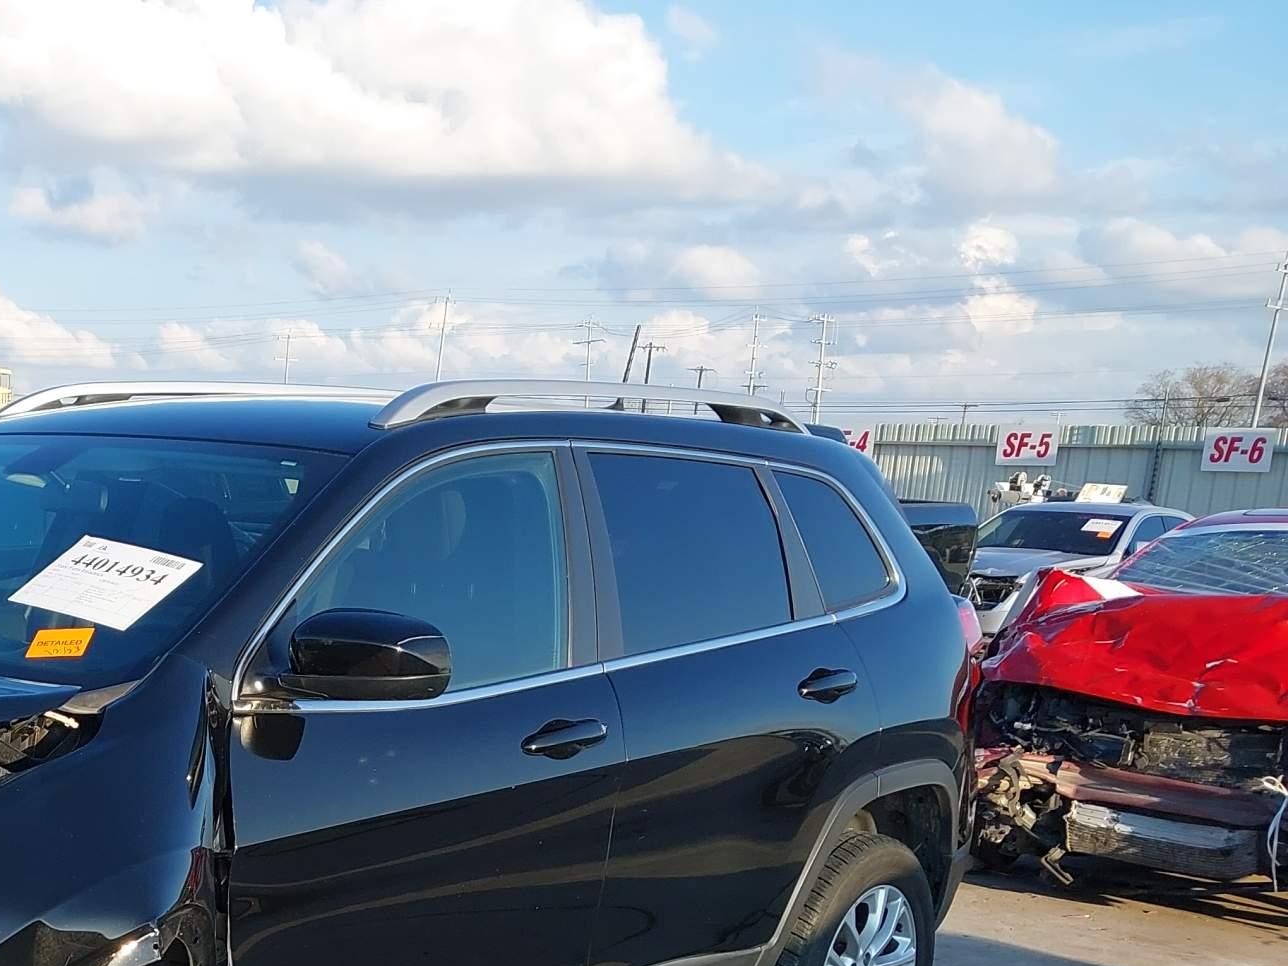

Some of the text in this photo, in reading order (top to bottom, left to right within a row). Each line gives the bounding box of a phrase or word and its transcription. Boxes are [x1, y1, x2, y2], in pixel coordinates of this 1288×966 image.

[1002, 432, 1053, 459] SF-5
[1209, 436, 1268, 464] SF-6
[71, 553, 169, 586] 44014934
[36, 639, 83, 648] DETAILED
